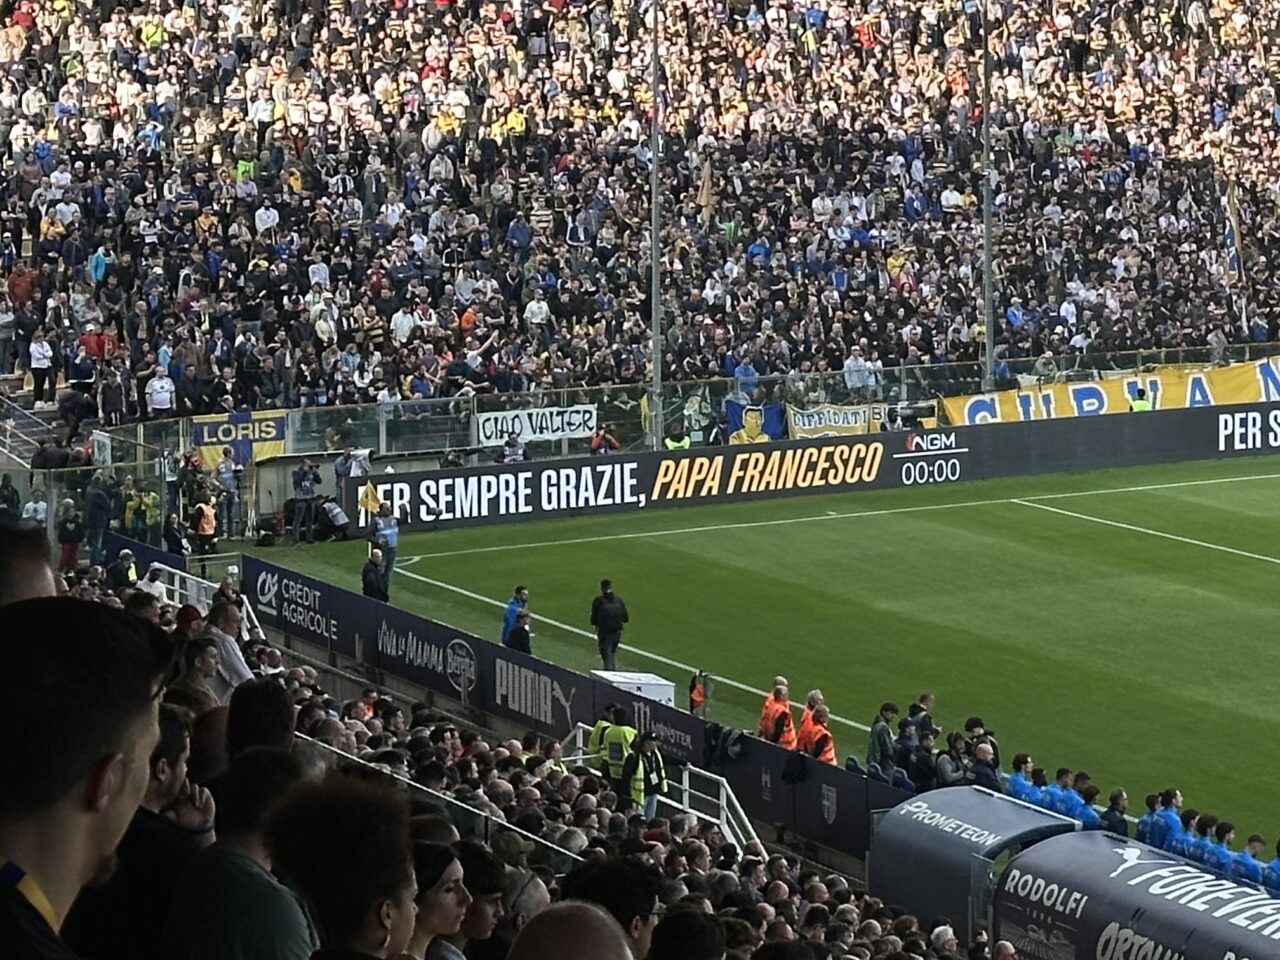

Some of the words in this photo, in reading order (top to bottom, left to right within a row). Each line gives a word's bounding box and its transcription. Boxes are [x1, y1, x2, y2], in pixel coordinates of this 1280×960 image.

[203, 421, 277, 442] LORIS
[482, 414, 523, 440] CIAO
[527, 409, 595, 435] VALTER
[1219, 413, 1262, 452] PER
[419, 471, 533, 522] SEMPRE
[541, 462, 646, 511] GRAZIE,
[651, 455, 724, 501] PAPA
[727, 441, 884, 494] FRANCESCO
[902, 459, 961, 486] 00:00
[281, 578, 321, 610] CRÉDIT
[282, 602, 338, 640] AGRICOLE
[406, 631, 444, 674] MAMMA
[495, 658, 553, 725] PUMA
[900, 801, 1001, 847] PROMETEON
[1004, 868, 1089, 920] RODOLFI
